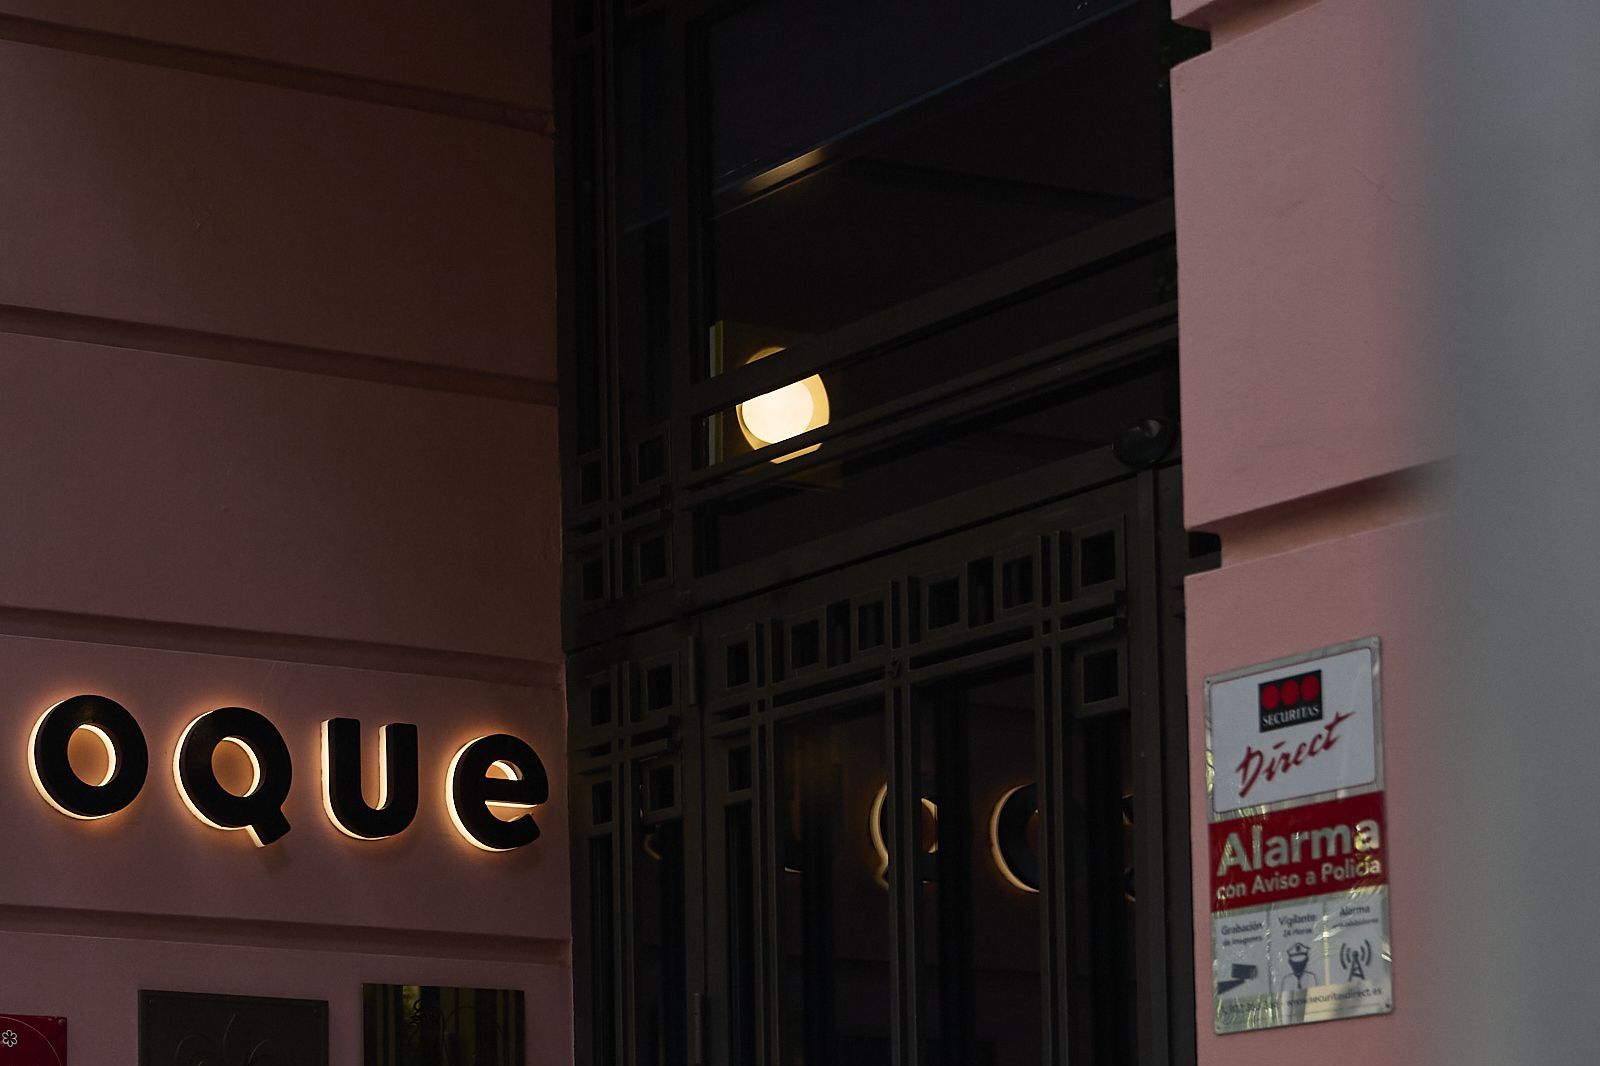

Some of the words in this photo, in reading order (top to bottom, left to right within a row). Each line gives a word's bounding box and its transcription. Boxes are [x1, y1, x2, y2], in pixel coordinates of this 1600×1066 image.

[1262, 704, 1320, 727] SECURITAS
[1235, 711, 1356, 798] Direct
[1215, 818, 1380, 877] Alarma
[1215, 882, 1247, 900] con
[1251, 872, 1300, 895] Aviso
[1305, 870, 1316, 886] a
[1321, 855, 1381, 882] Policía
[1278, 914, 1316, 928] Vigilante
